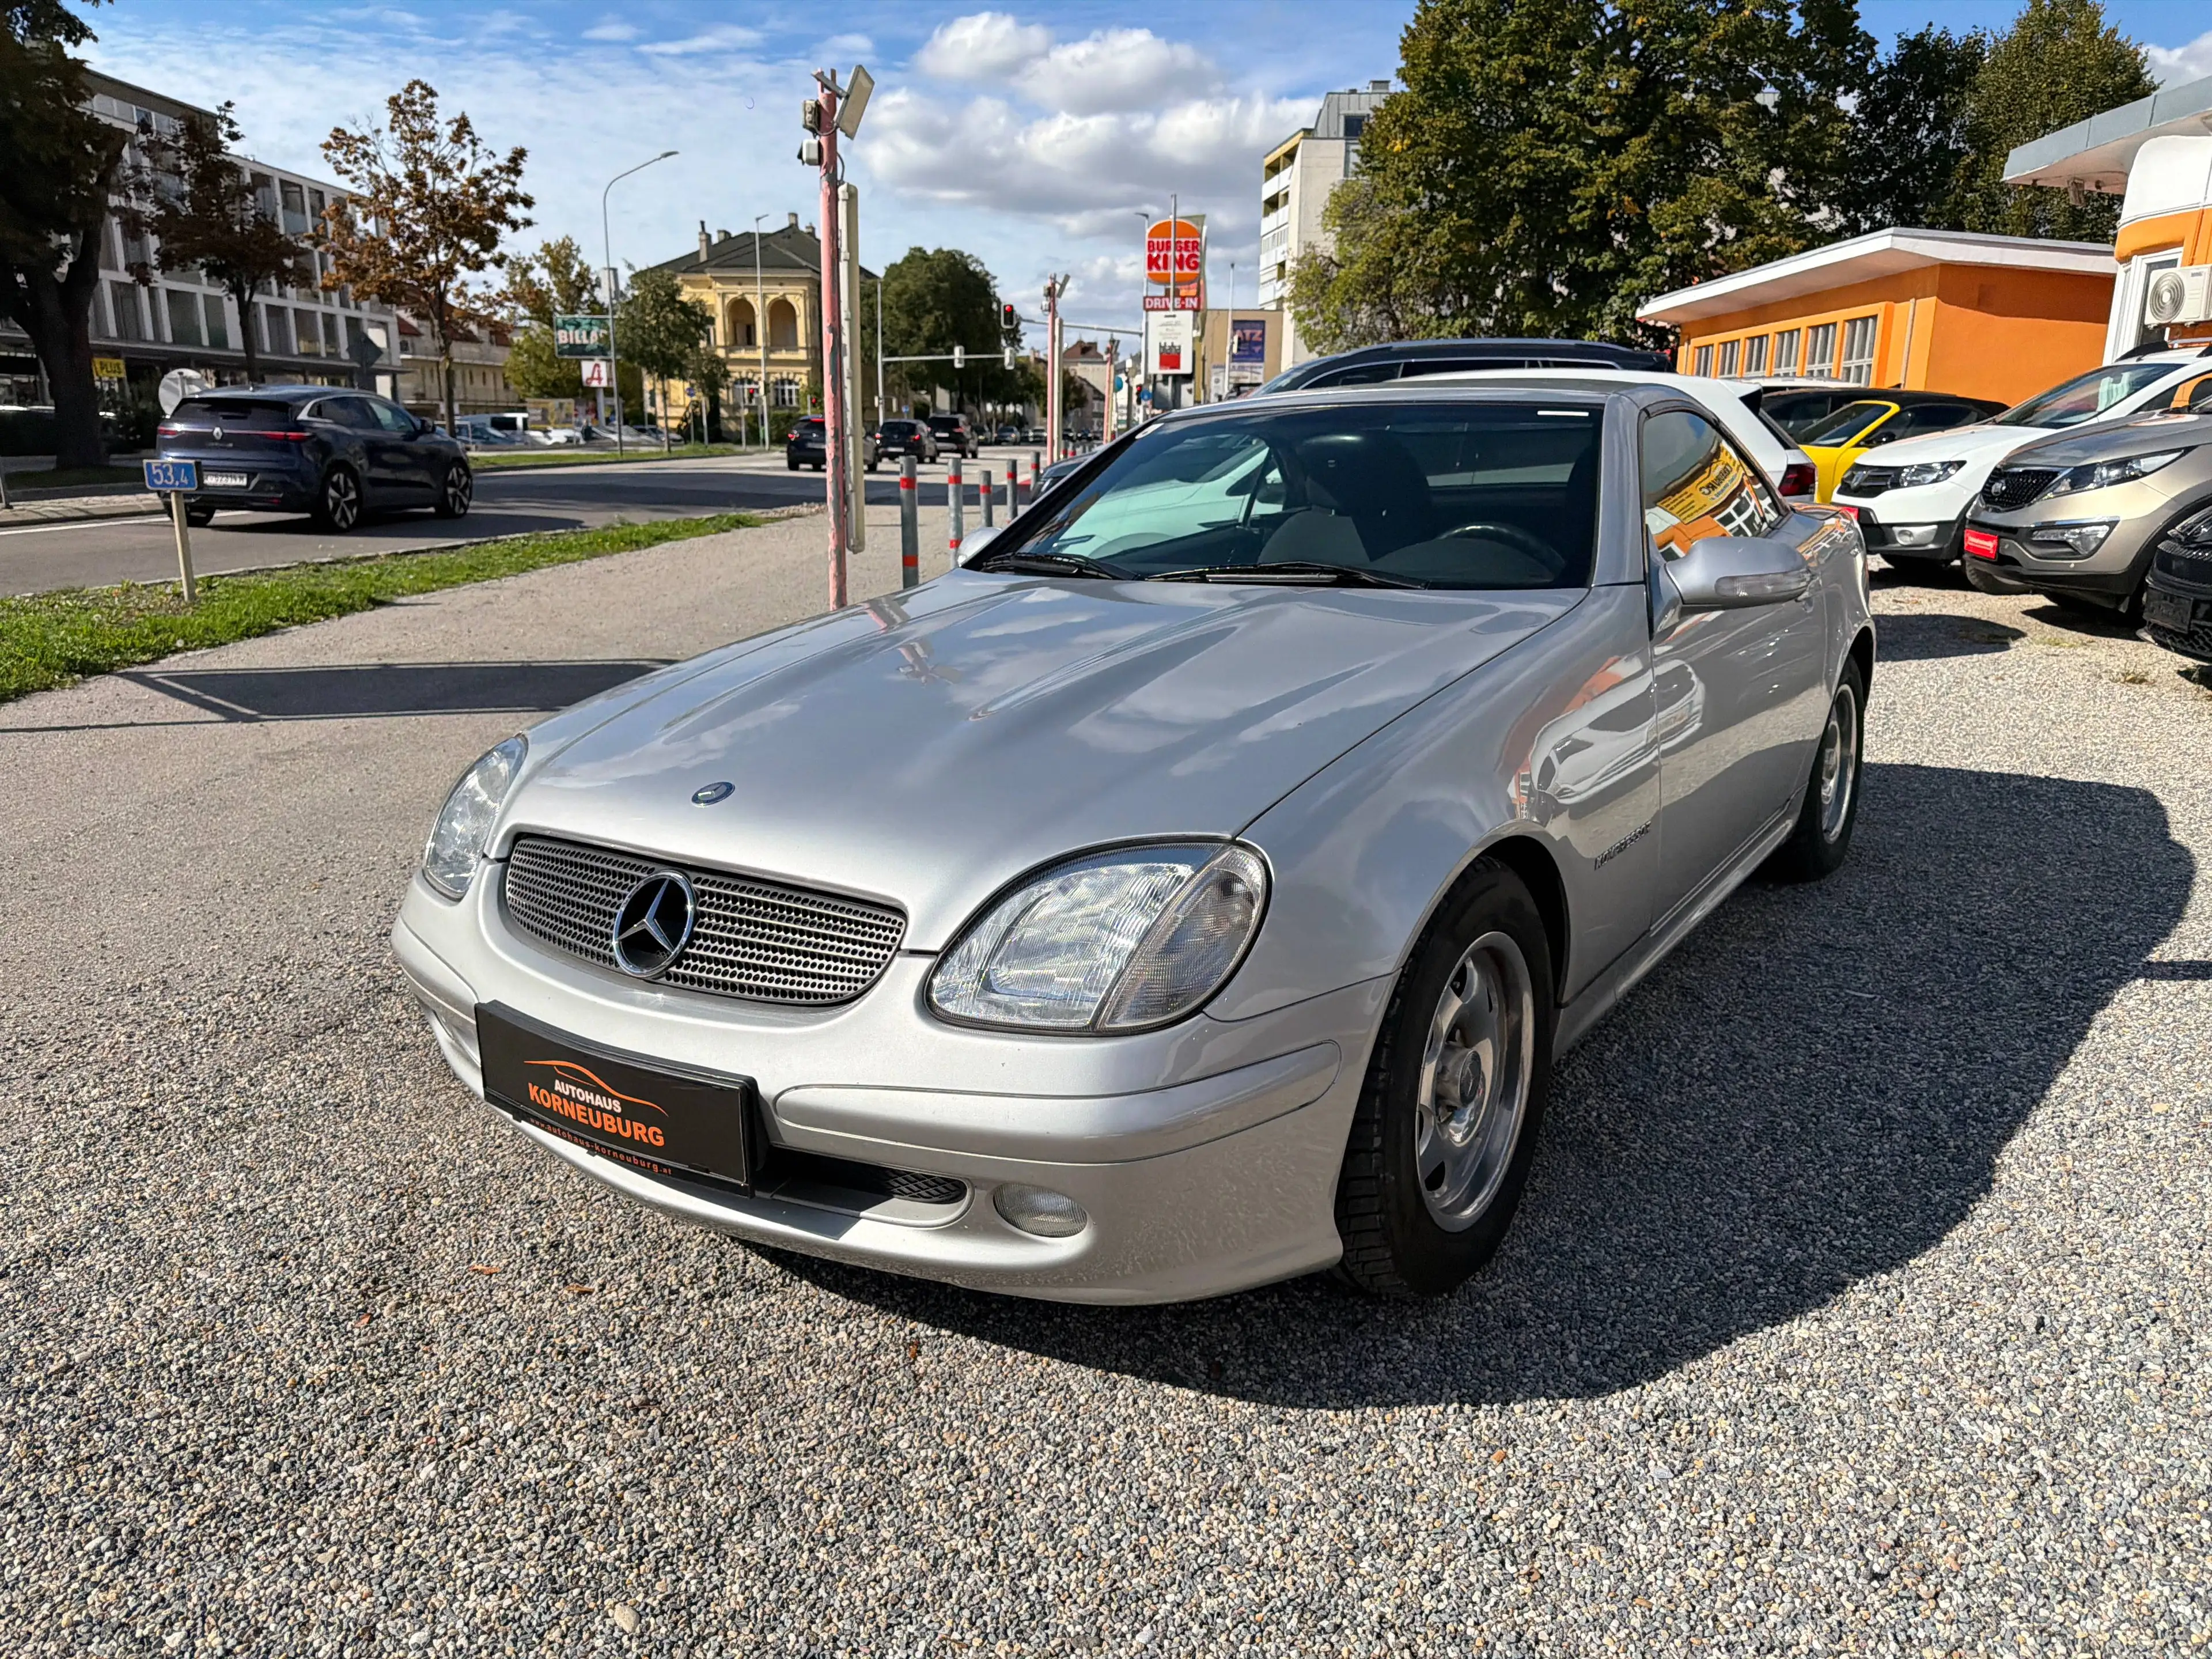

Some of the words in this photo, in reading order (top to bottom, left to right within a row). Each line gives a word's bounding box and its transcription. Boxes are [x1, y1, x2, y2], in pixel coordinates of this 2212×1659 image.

[1147, 240, 1199, 252] BURGER
[1147, 253, 1199, 271] KING
[1145, 297, 1198, 309] DRIVE-IN
[151, 463, 188, 486] 53,4
[554, 1080, 622, 1113] AUTOHAUS
[528, 1082, 665, 1146] KORNEUBURG
[530, 1118, 672, 1175] www.autohaus-korneuburg.at
